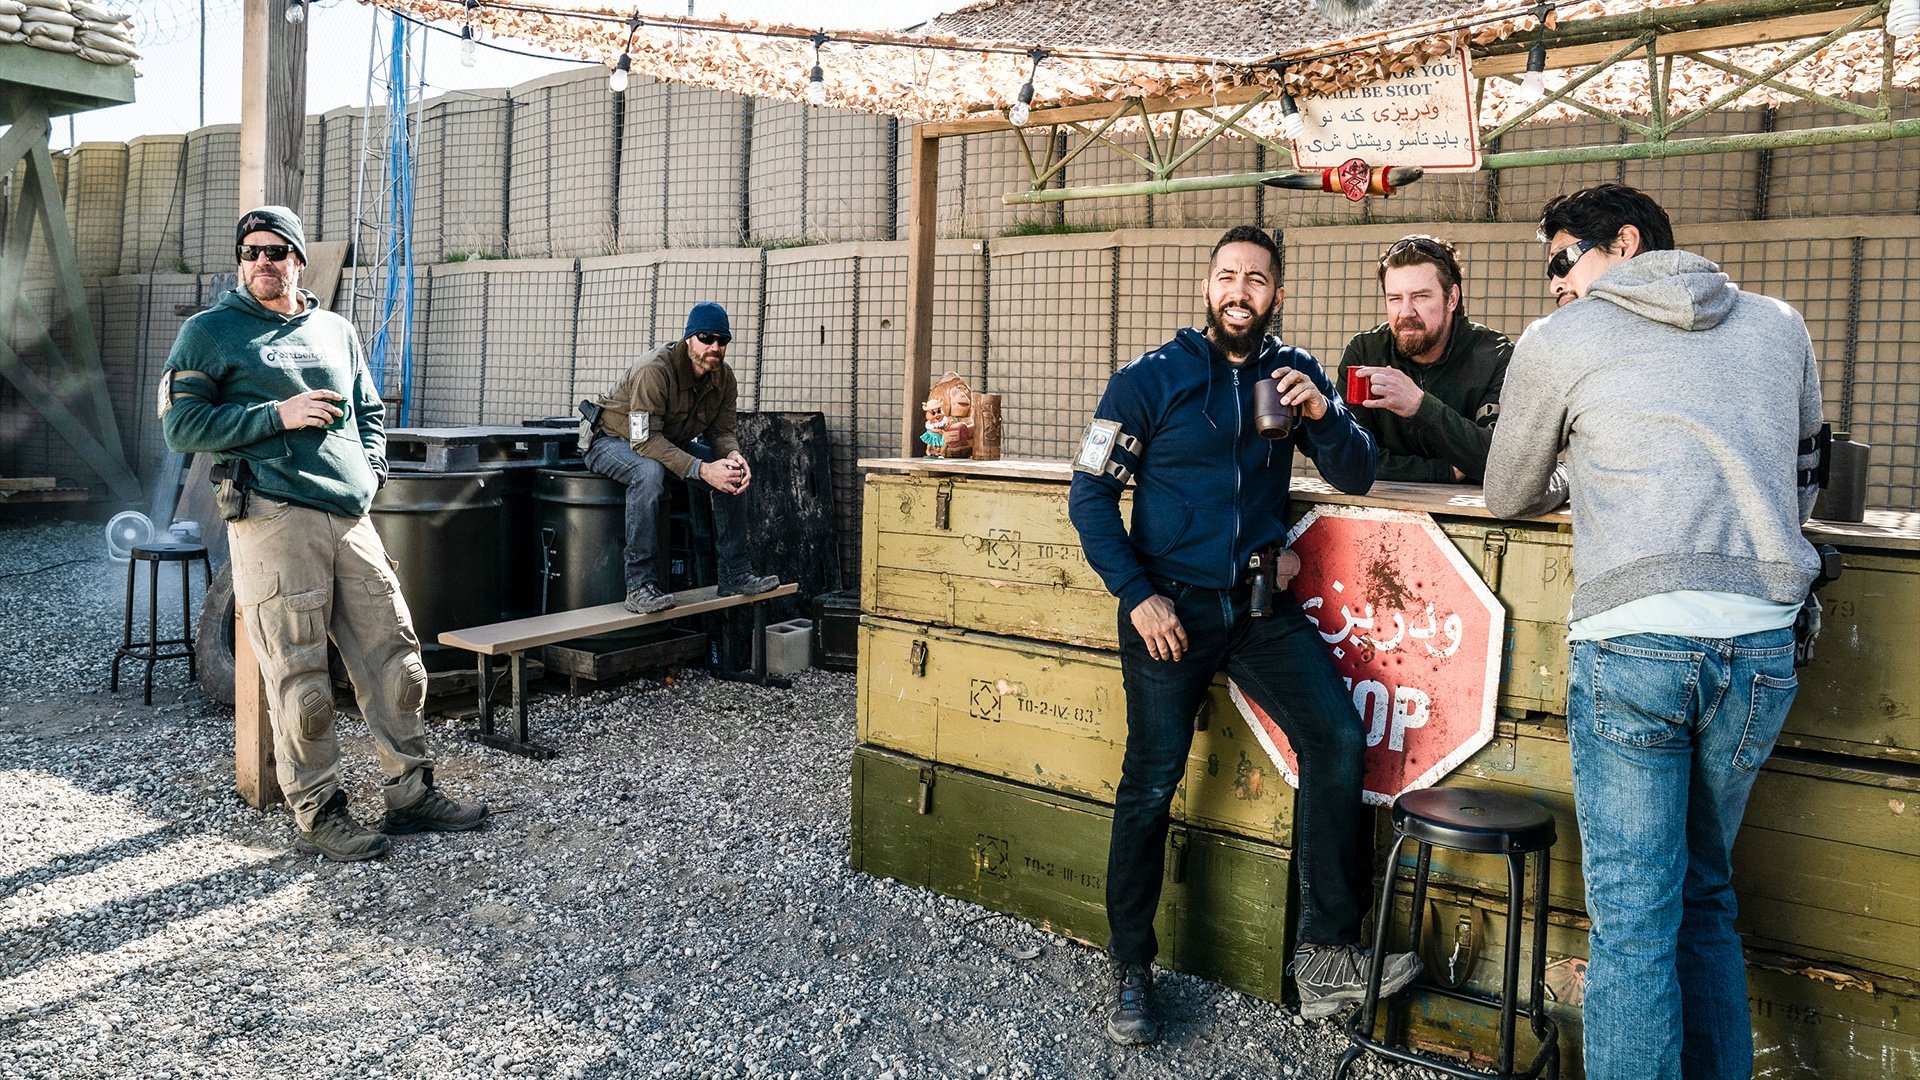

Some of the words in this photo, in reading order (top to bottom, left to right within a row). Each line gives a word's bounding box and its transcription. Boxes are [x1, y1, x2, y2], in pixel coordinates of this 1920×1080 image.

[1420, 64, 1457, 77] YOU
[1361, 86, 1383, 98] BE
[1386, 83, 1432, 97] SHOT
[1343, 676, 1431, 752] OP
